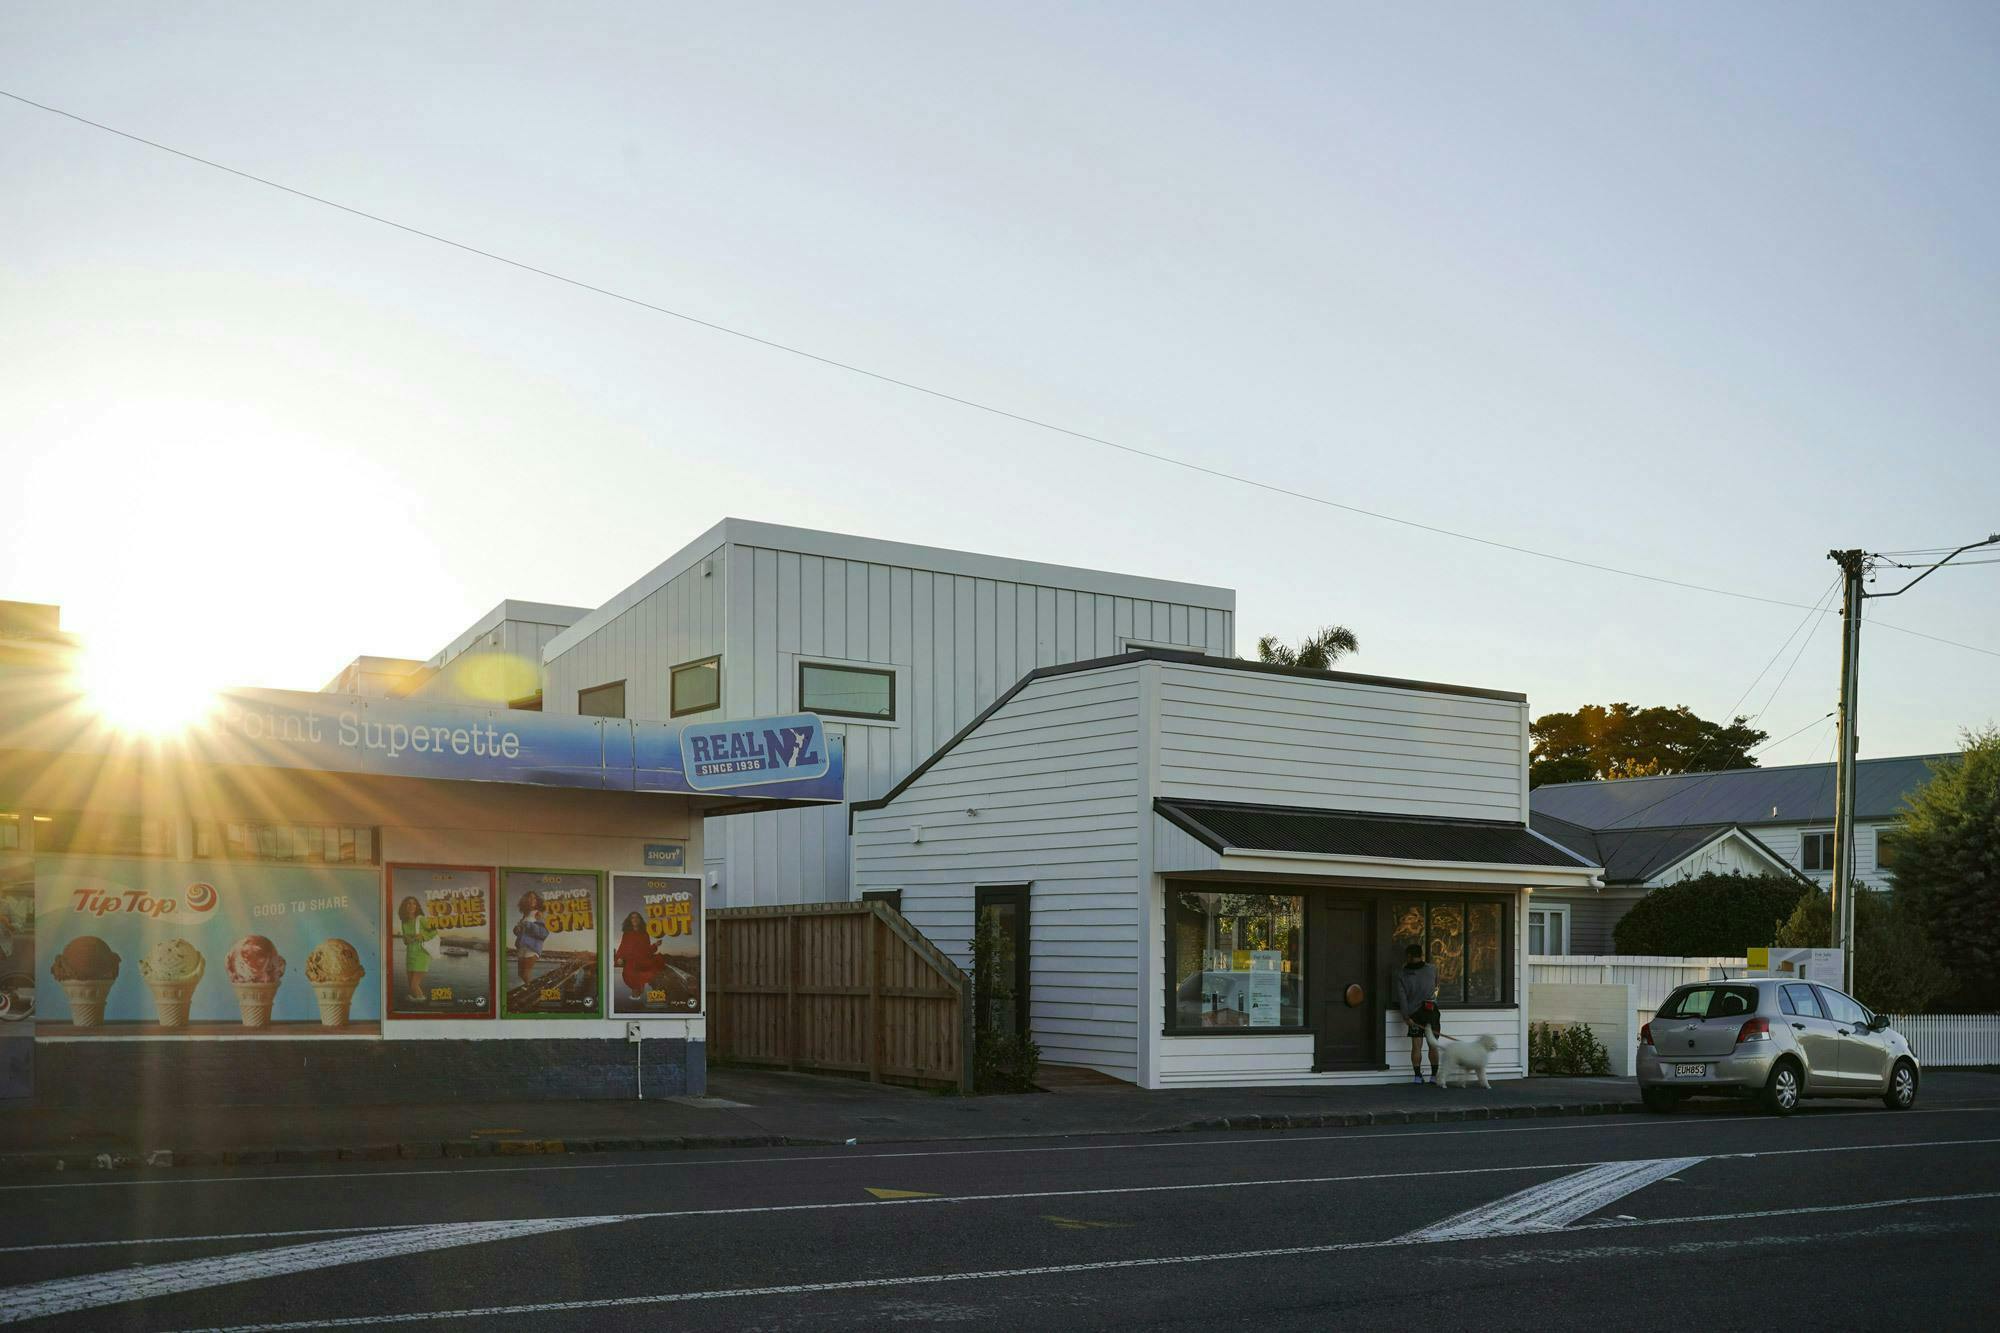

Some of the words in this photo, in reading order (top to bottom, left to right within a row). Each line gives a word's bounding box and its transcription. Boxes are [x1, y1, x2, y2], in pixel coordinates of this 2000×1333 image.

[338, 710, 520, 758] Superette
[691, 731, 765, 762] REAL
[763, 725, 819, 769] NZ
[702, 762, 733, 775] SINCE
[736, 760, 761, 771] 1936
[254, 902, 286, 916] GOOD
[290, 901, 305, 913] TO
[310, 896, 349, 911] SHARE
[645, 904, 663, 918] TO
[665, 901, 690, 915] EAT
[427, 912, 483, 929] MOVIES
[545, 911, 591, 932] GYM
[646, 916, 691, 938] OUT
